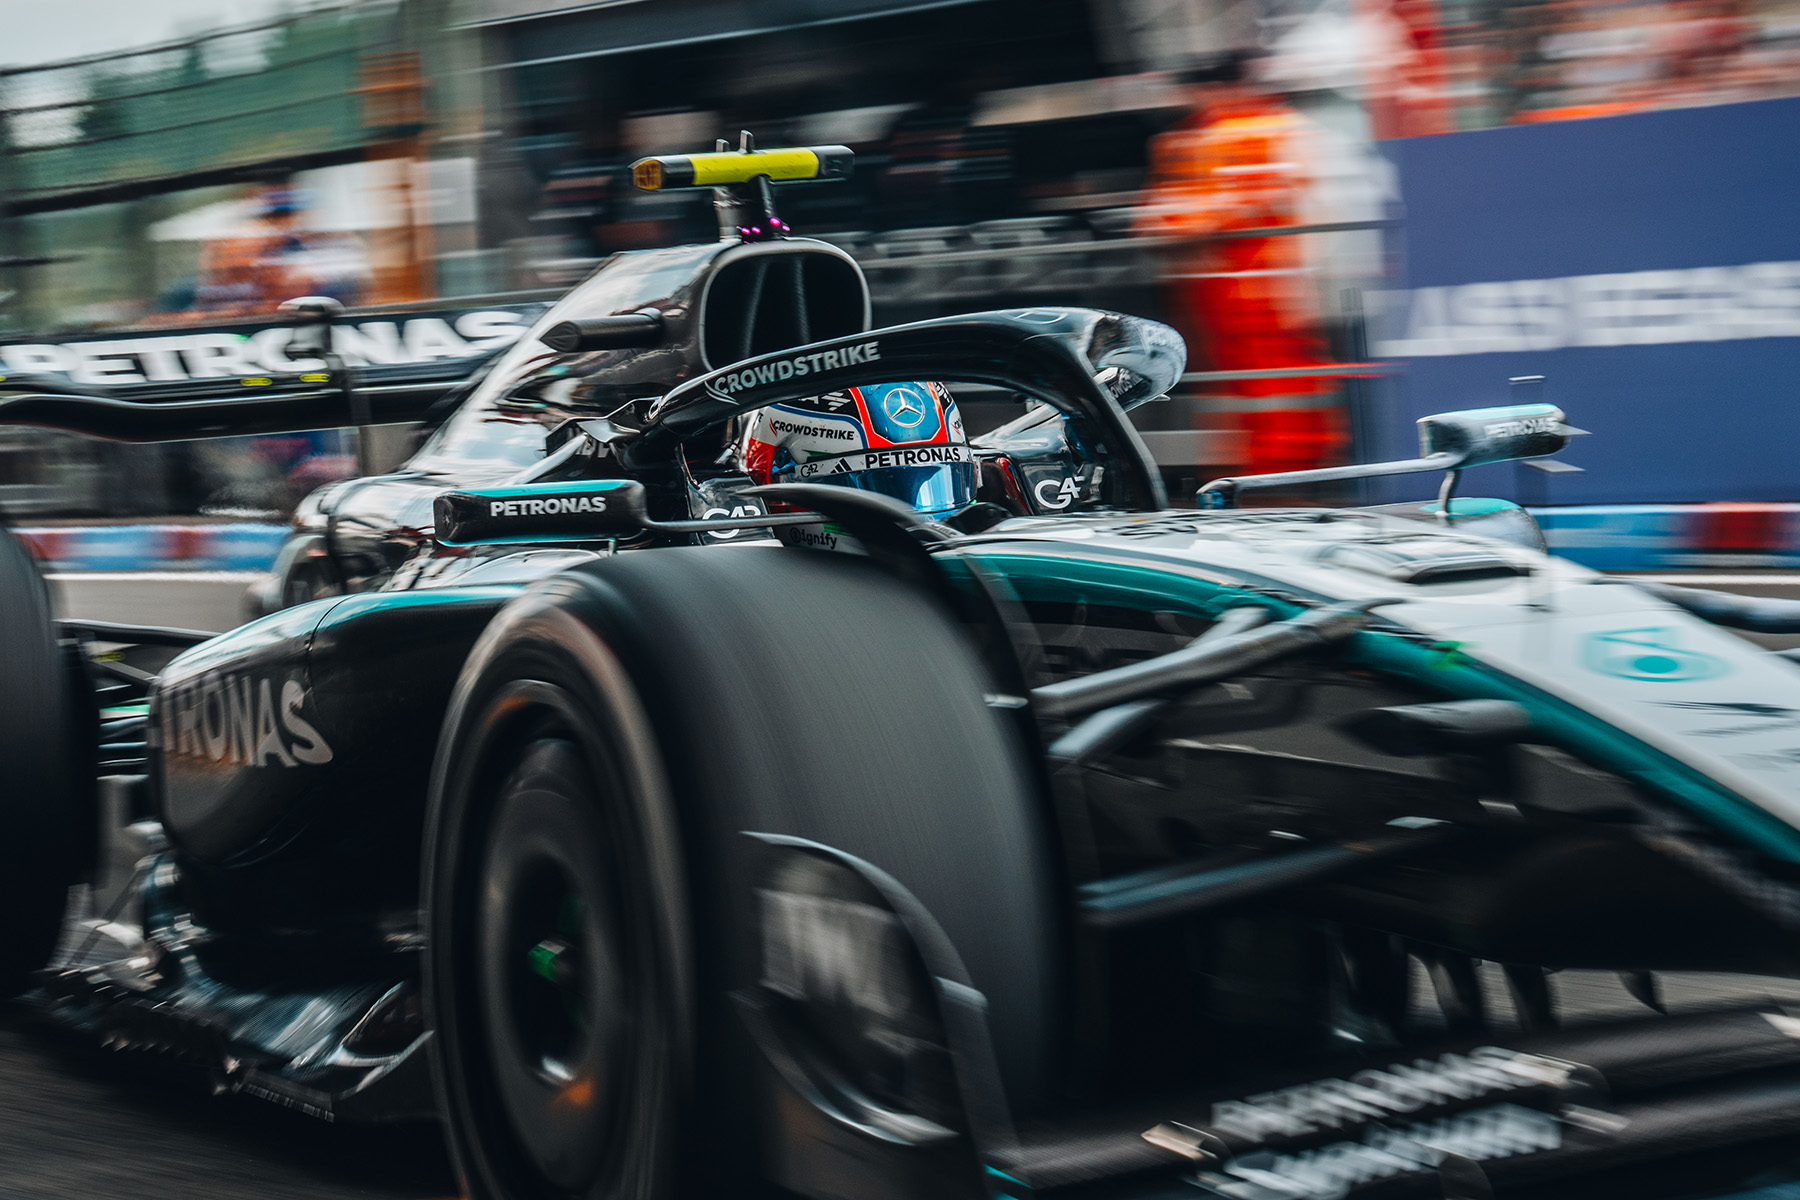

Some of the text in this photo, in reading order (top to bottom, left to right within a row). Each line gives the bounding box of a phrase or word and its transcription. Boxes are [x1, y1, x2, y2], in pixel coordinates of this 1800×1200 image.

[713, 341, 881, 395] CROWDSTRIKE
[773, 420, 855, 441] CROWDSTRIKE
[865, 447, 961, 469] PETRONAS
[800, 463, 819, 478] G42
[490, 497, 607, 516] PETRONAS
